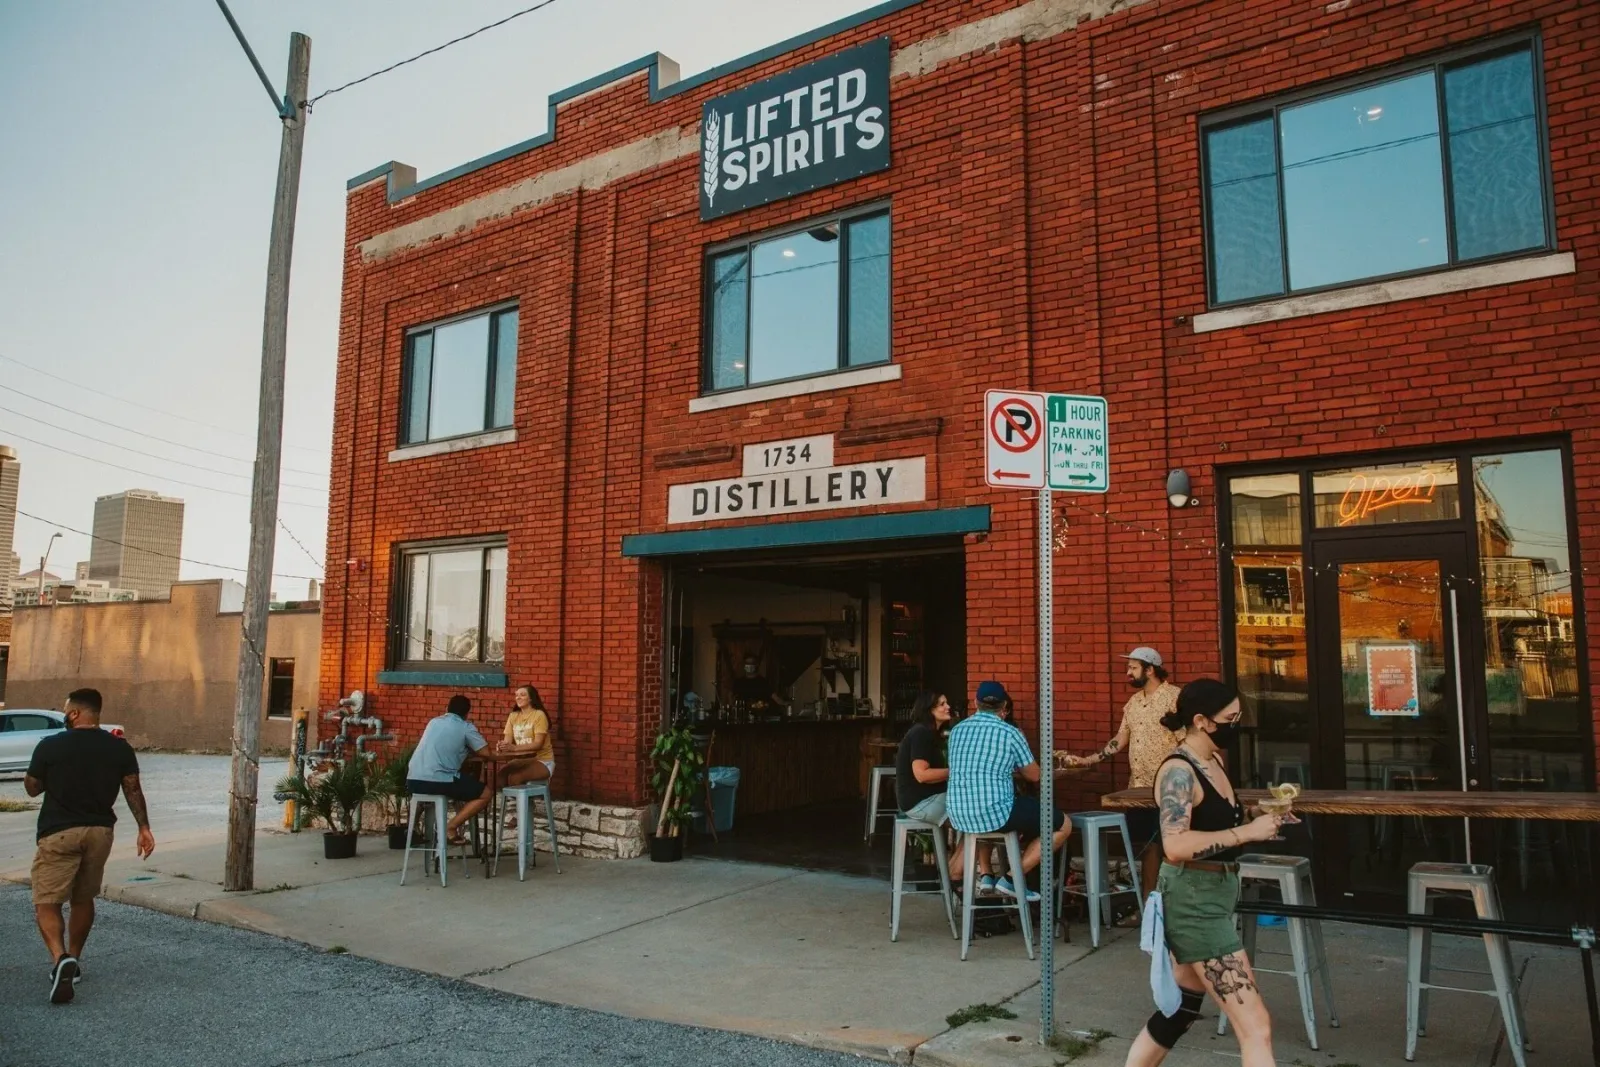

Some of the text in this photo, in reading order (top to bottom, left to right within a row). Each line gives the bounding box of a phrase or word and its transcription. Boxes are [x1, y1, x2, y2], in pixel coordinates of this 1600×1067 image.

[723, 68, 867, 151] LIFTED
[722, 106, 885, 191] SPIRITS
[1053, 402, 1101, 422] 1 HOUR
[1053, 427, 1101, 440] PARKING
[764, 443, 812, 468] 1734
[1091, 461, 1103, 469] FRI
[691, 466, 894, 517] DISTILLERY
[1340, 472, 1436, 519] Open
